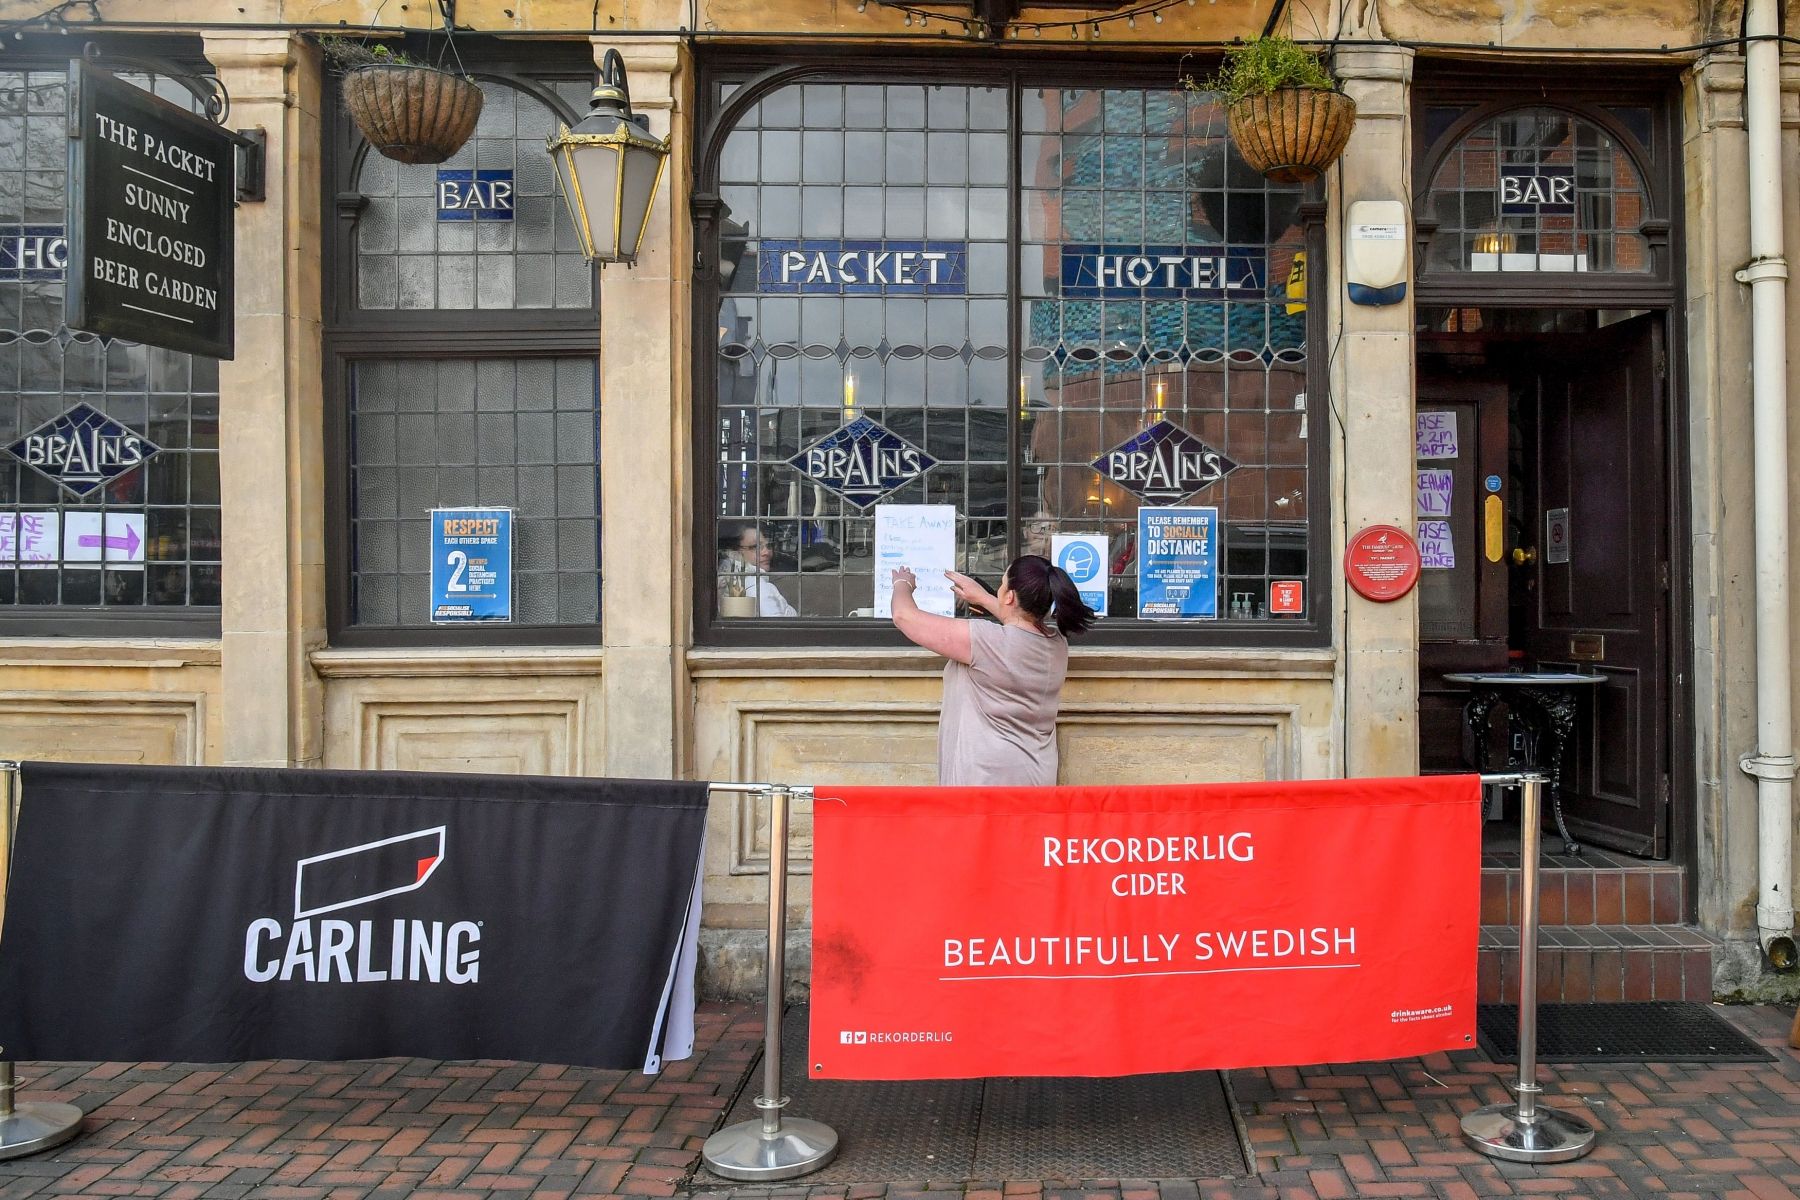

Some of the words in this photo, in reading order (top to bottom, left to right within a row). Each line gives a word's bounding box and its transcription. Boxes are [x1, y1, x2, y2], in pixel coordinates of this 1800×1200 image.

[96, 112, 138, 152] THE
[144, 133, 216, 182] PACKET
[440, 182, 511, 208] BAR
[501, 177, 569, 203] BAR
[125, 183, 190, 224] SUNNY
[18, 237, 68, 269] HO
[106, 217, 206, 268] ENCLOSED
[782, 252, 946, 284] PACKET
[1098, 256, 1241, 288] HOTEL
[94, 256, 139, 290] BEER
[145, 272, 217, 310] GARDEN
[1418, 414, 1446, 429] ASE
[1416, 444, 1448, 456] PART
[1418, 493, 1450, 515] NLY
[0, 514, 44, 534] EASE
[444, 520, 499, 535] RESPECT
[884, 516, 915, 528] TAKE
[1148, 516, 1172, 525] PLEASE
[1173, 516, 1208, 525] REMEMBER
[1418, 523, 1448, 540] ASE
[1148, 526, 1160, 538] TO
[1164, 526, 1208, 538] SOCIALLY
[1148, 540, 1208, 555] DISTANCE
[1421, 541, 1448, 556] IAL
[448, 550, 466, 592] 2
[1421, 556, 1454, 567] TANCE
[1043, 832, 1254, 867] REKORDERLIG
[1111, 872, 1186, 896] CIDER
[244, 917, 481, 985] CARLING
[944, 934, 1180, 967] BEAUTIFULLY
[1194, 927, 1357, 960] SWEDISH
[1391, 1004, 1452, 1018] drinkaware.co.uk
[870, 1032, 953, 1042] REKORDERLIG
